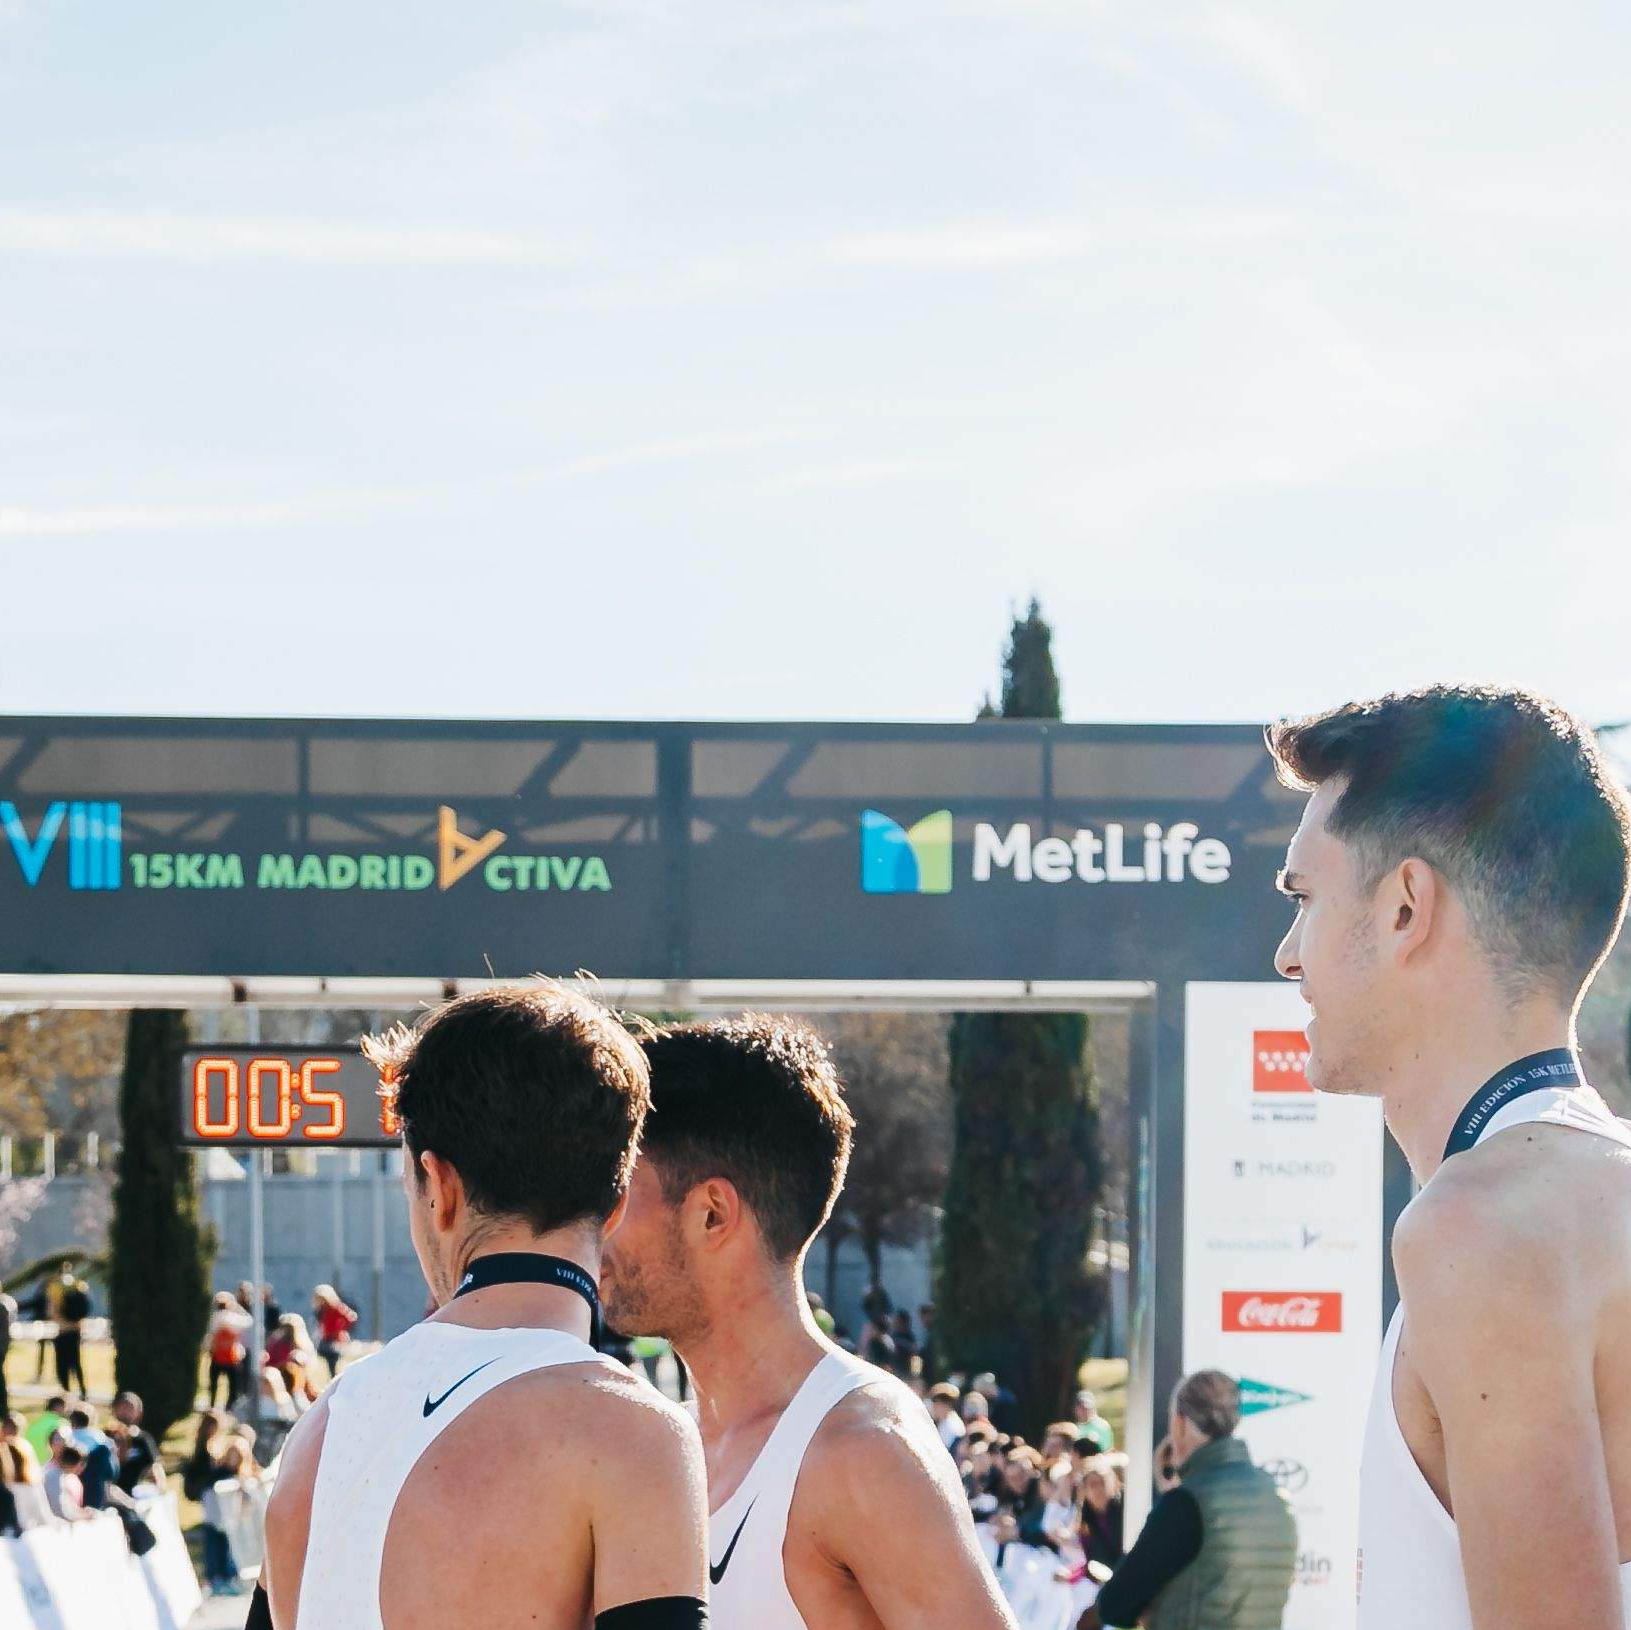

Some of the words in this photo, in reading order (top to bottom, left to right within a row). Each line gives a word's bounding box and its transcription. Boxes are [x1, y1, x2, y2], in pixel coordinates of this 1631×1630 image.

[129, 853, 244, 889] 15KM
[258, 853, 434, 891] MADRID
[972, 821, 1232, 885] MetLife
